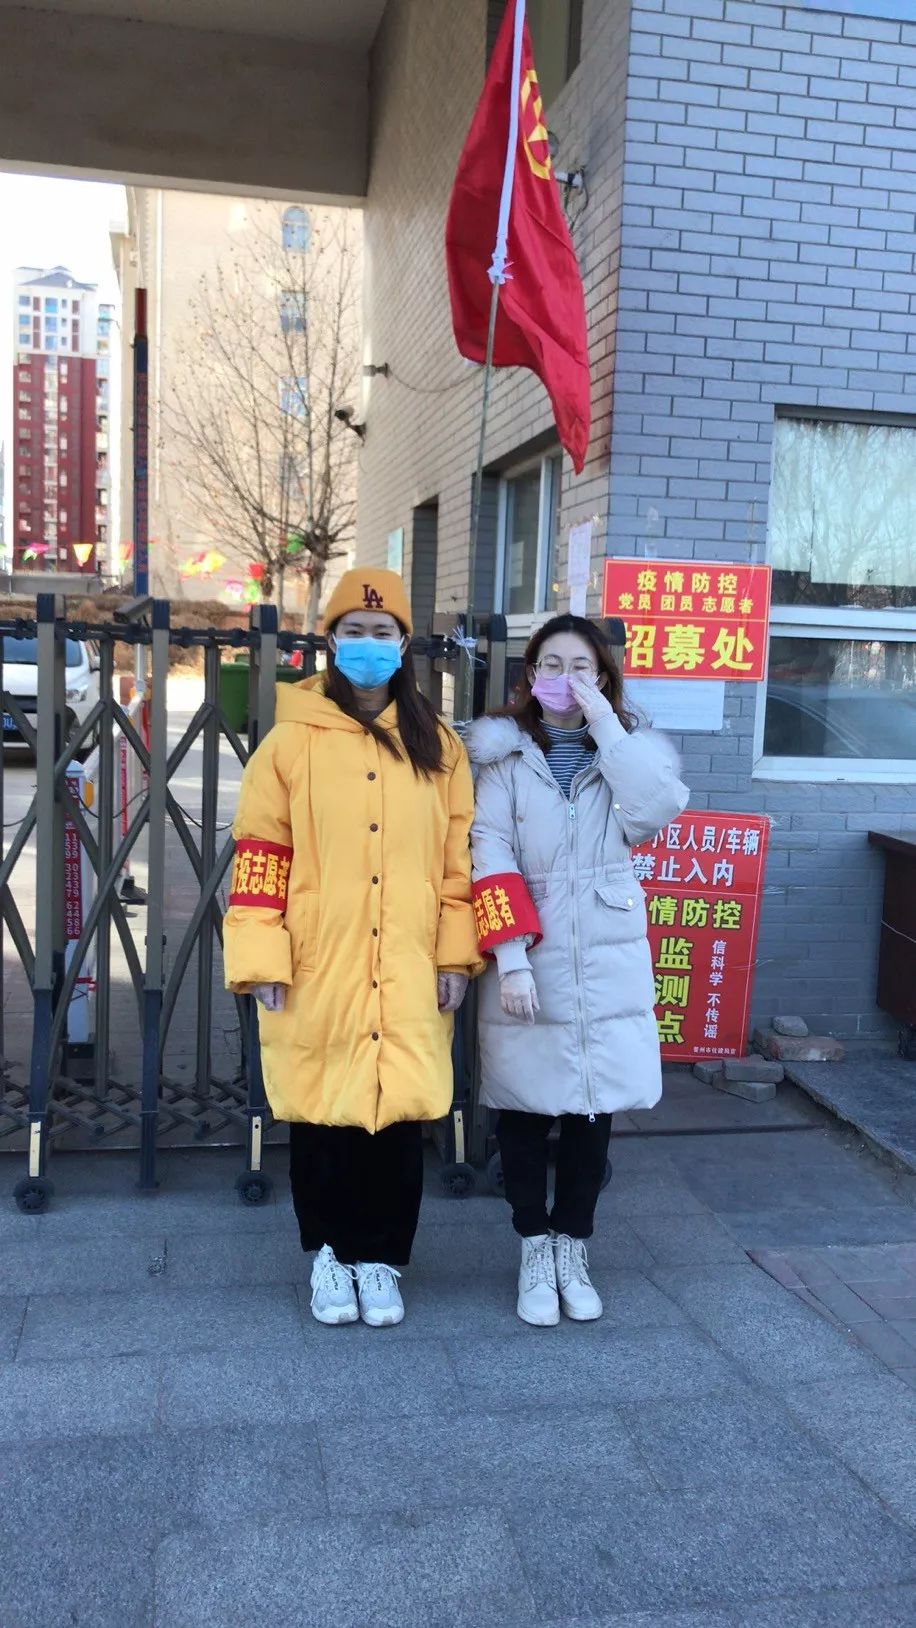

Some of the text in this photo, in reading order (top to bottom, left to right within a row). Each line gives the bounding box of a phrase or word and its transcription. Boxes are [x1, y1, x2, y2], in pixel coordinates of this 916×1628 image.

[362, 584, 384, 609] LA
[637, 570, 738, 595] 疫情防控
[618, 593, 754, 614] 党员 团员 志愿者
[623, 622, 754, 671] 招募处
[632, 853, 734, 887] 禁止入内
[648, 895, 742, 929] 情防控
[654, 937, 694, 1044] 监测点
[704, 940, 727, 1039] 信科学 不传谣
